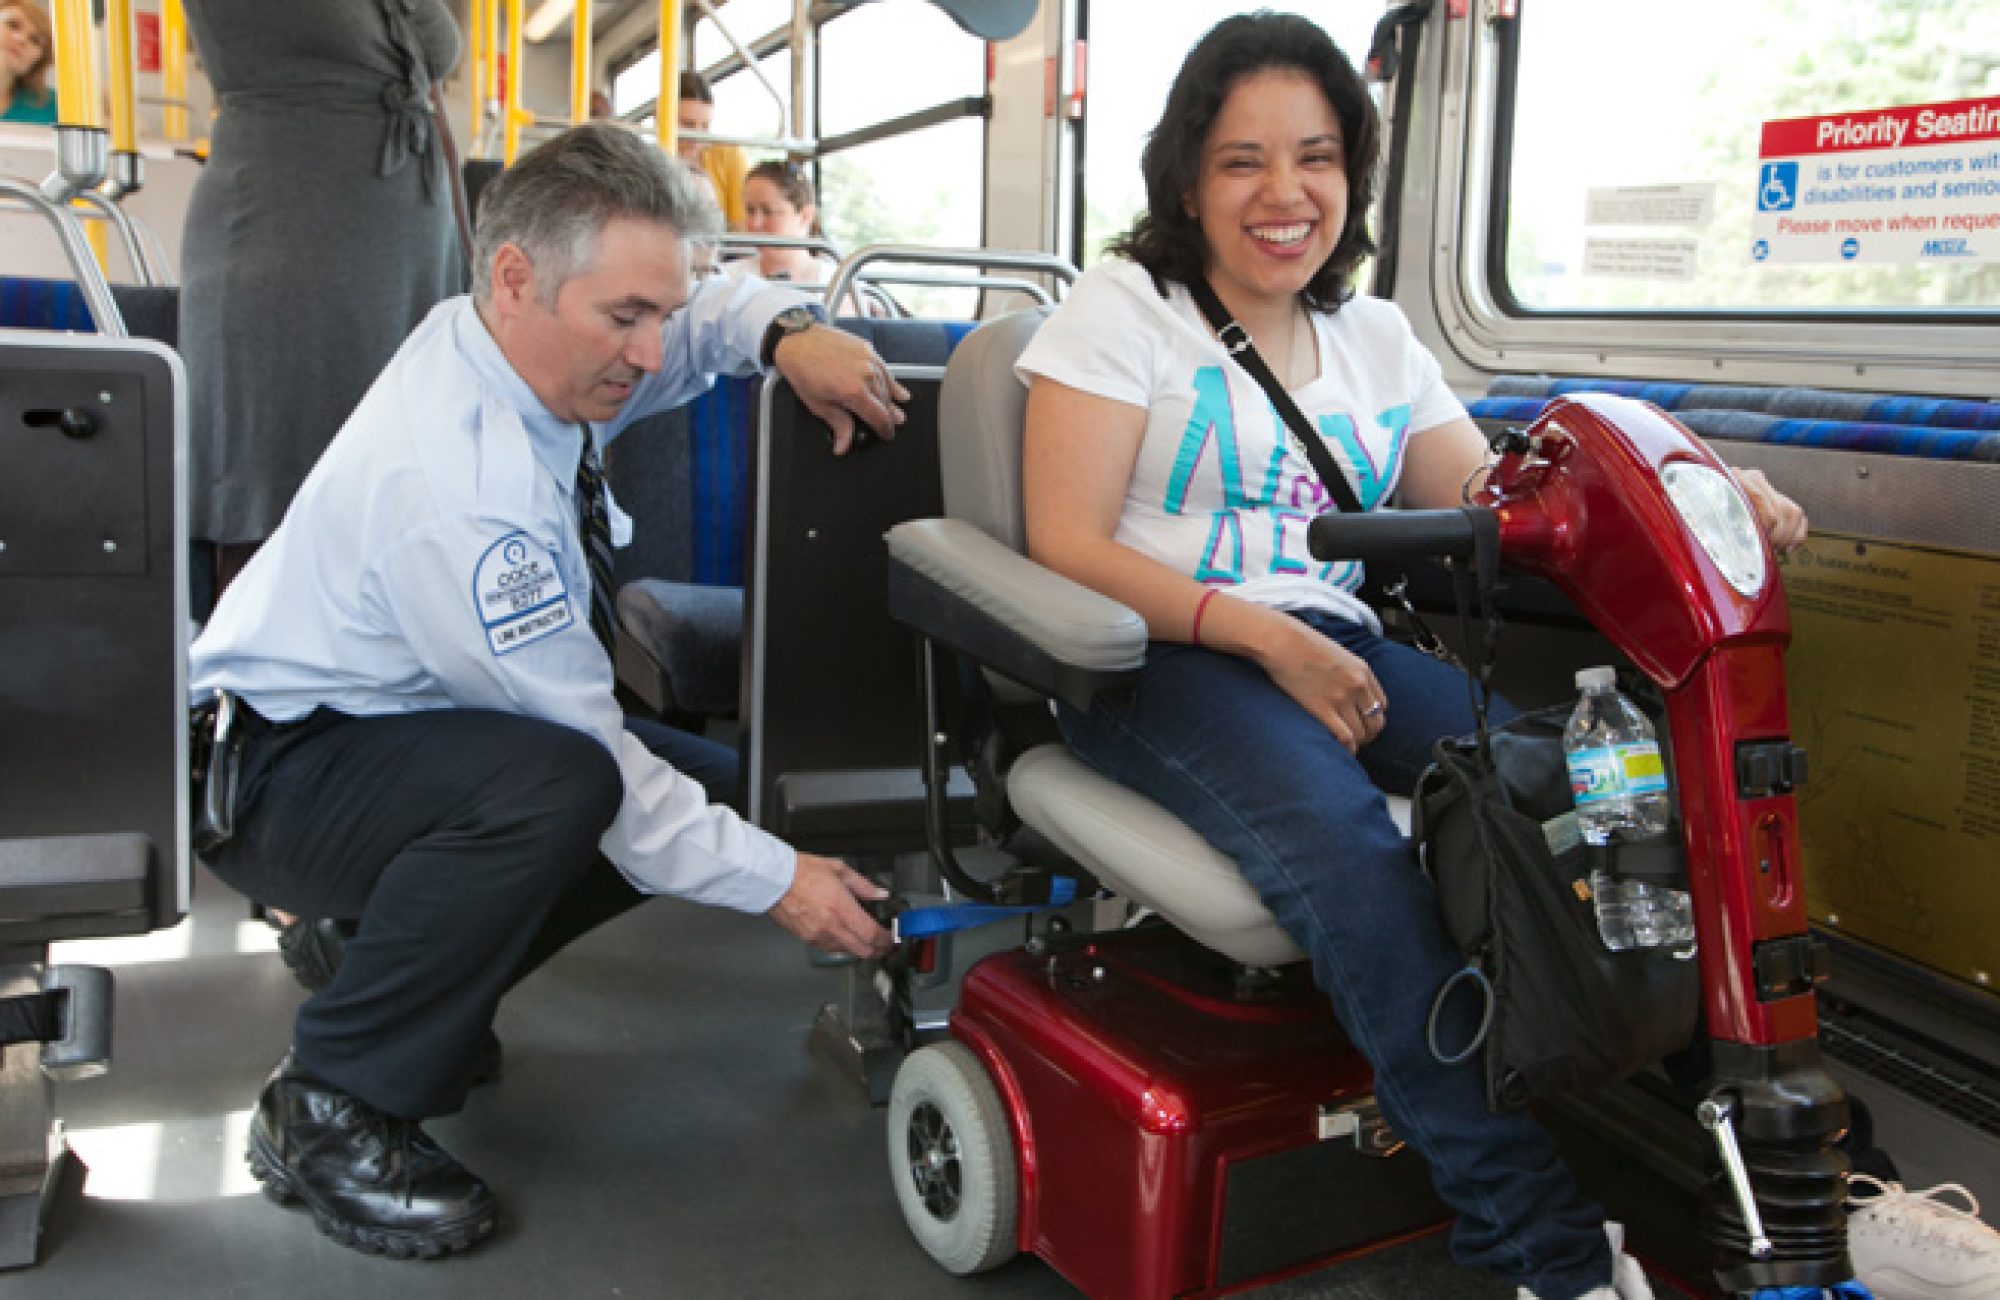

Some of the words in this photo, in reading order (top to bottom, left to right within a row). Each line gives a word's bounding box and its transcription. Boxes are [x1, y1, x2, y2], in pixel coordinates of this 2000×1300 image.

[1817, 115, 1909, 148] Priority
[1817, 164, 1833, 181] is
[1837, 162, 1860, 180] for
[1865, 157, 1964, 178] customers
[1804, 185, 1896, 204] disabilities
[1901, 181, 1937, 200] and
[1777, 216, 1832, 235] Please
[1835, 217, 1884, 233] move
[1887, 213, 1937, 232] when
